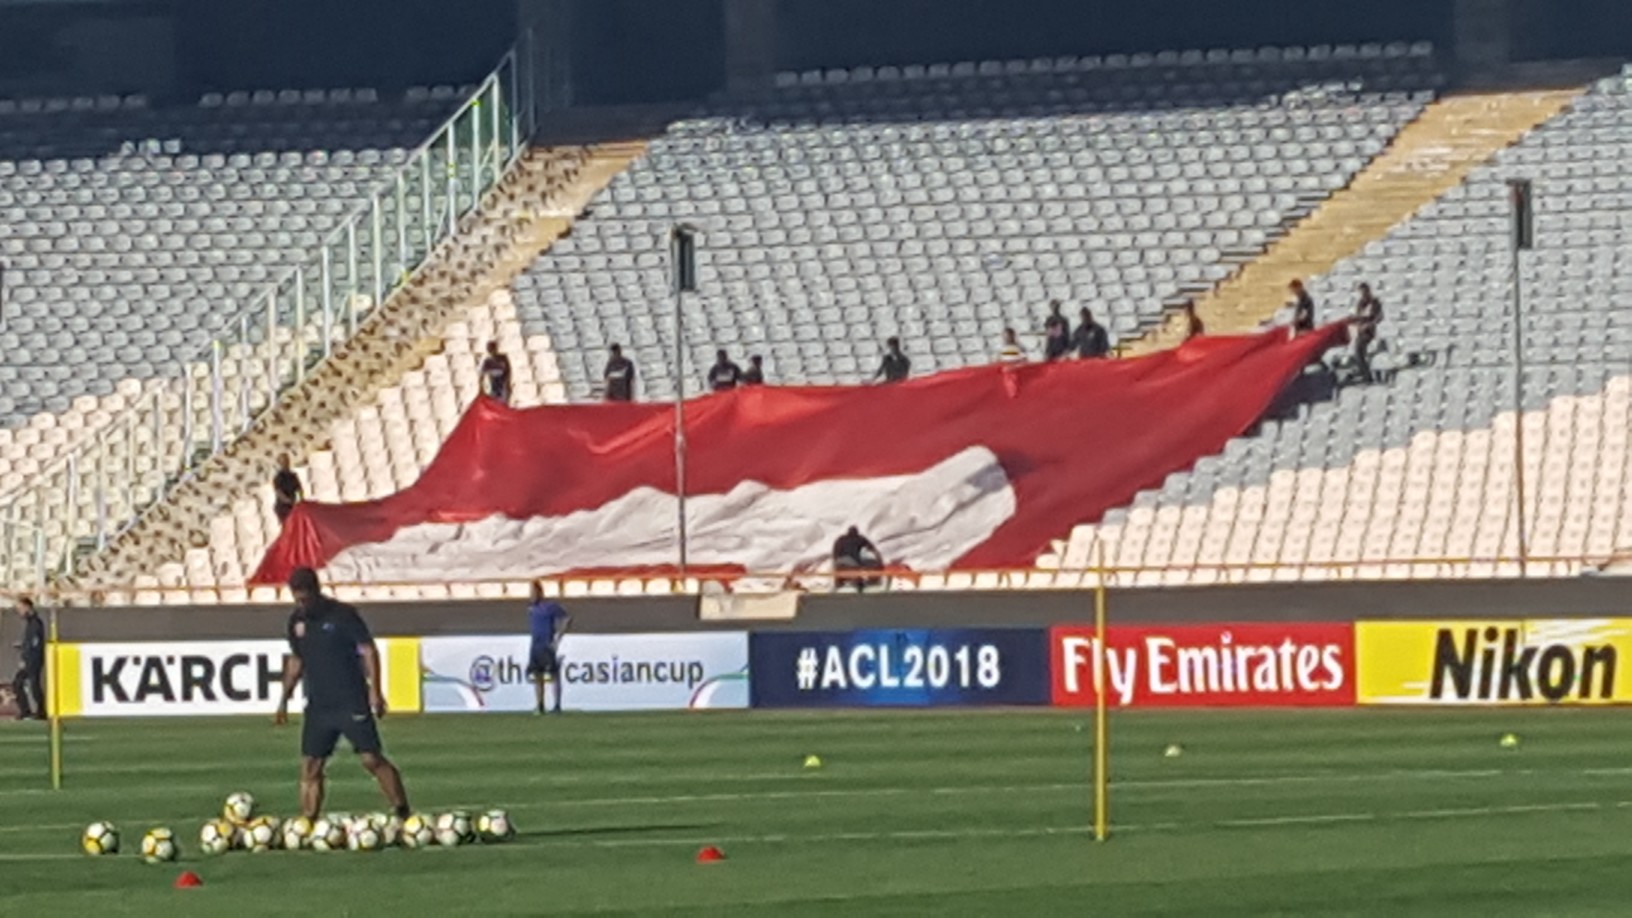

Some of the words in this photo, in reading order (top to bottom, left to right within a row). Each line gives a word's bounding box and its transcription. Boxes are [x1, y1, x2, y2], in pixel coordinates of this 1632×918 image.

[91, 653, 298, 702] KÄRCH
[469, 655, 704, 691] @thcasiancup
[796, 644, 1000, 690] #ACL2018
[1062, 636, 1138, 705] Fly
[1146, 631, 1344, 694] Emirates
[1429, 626, 1618, 703] Nikon
